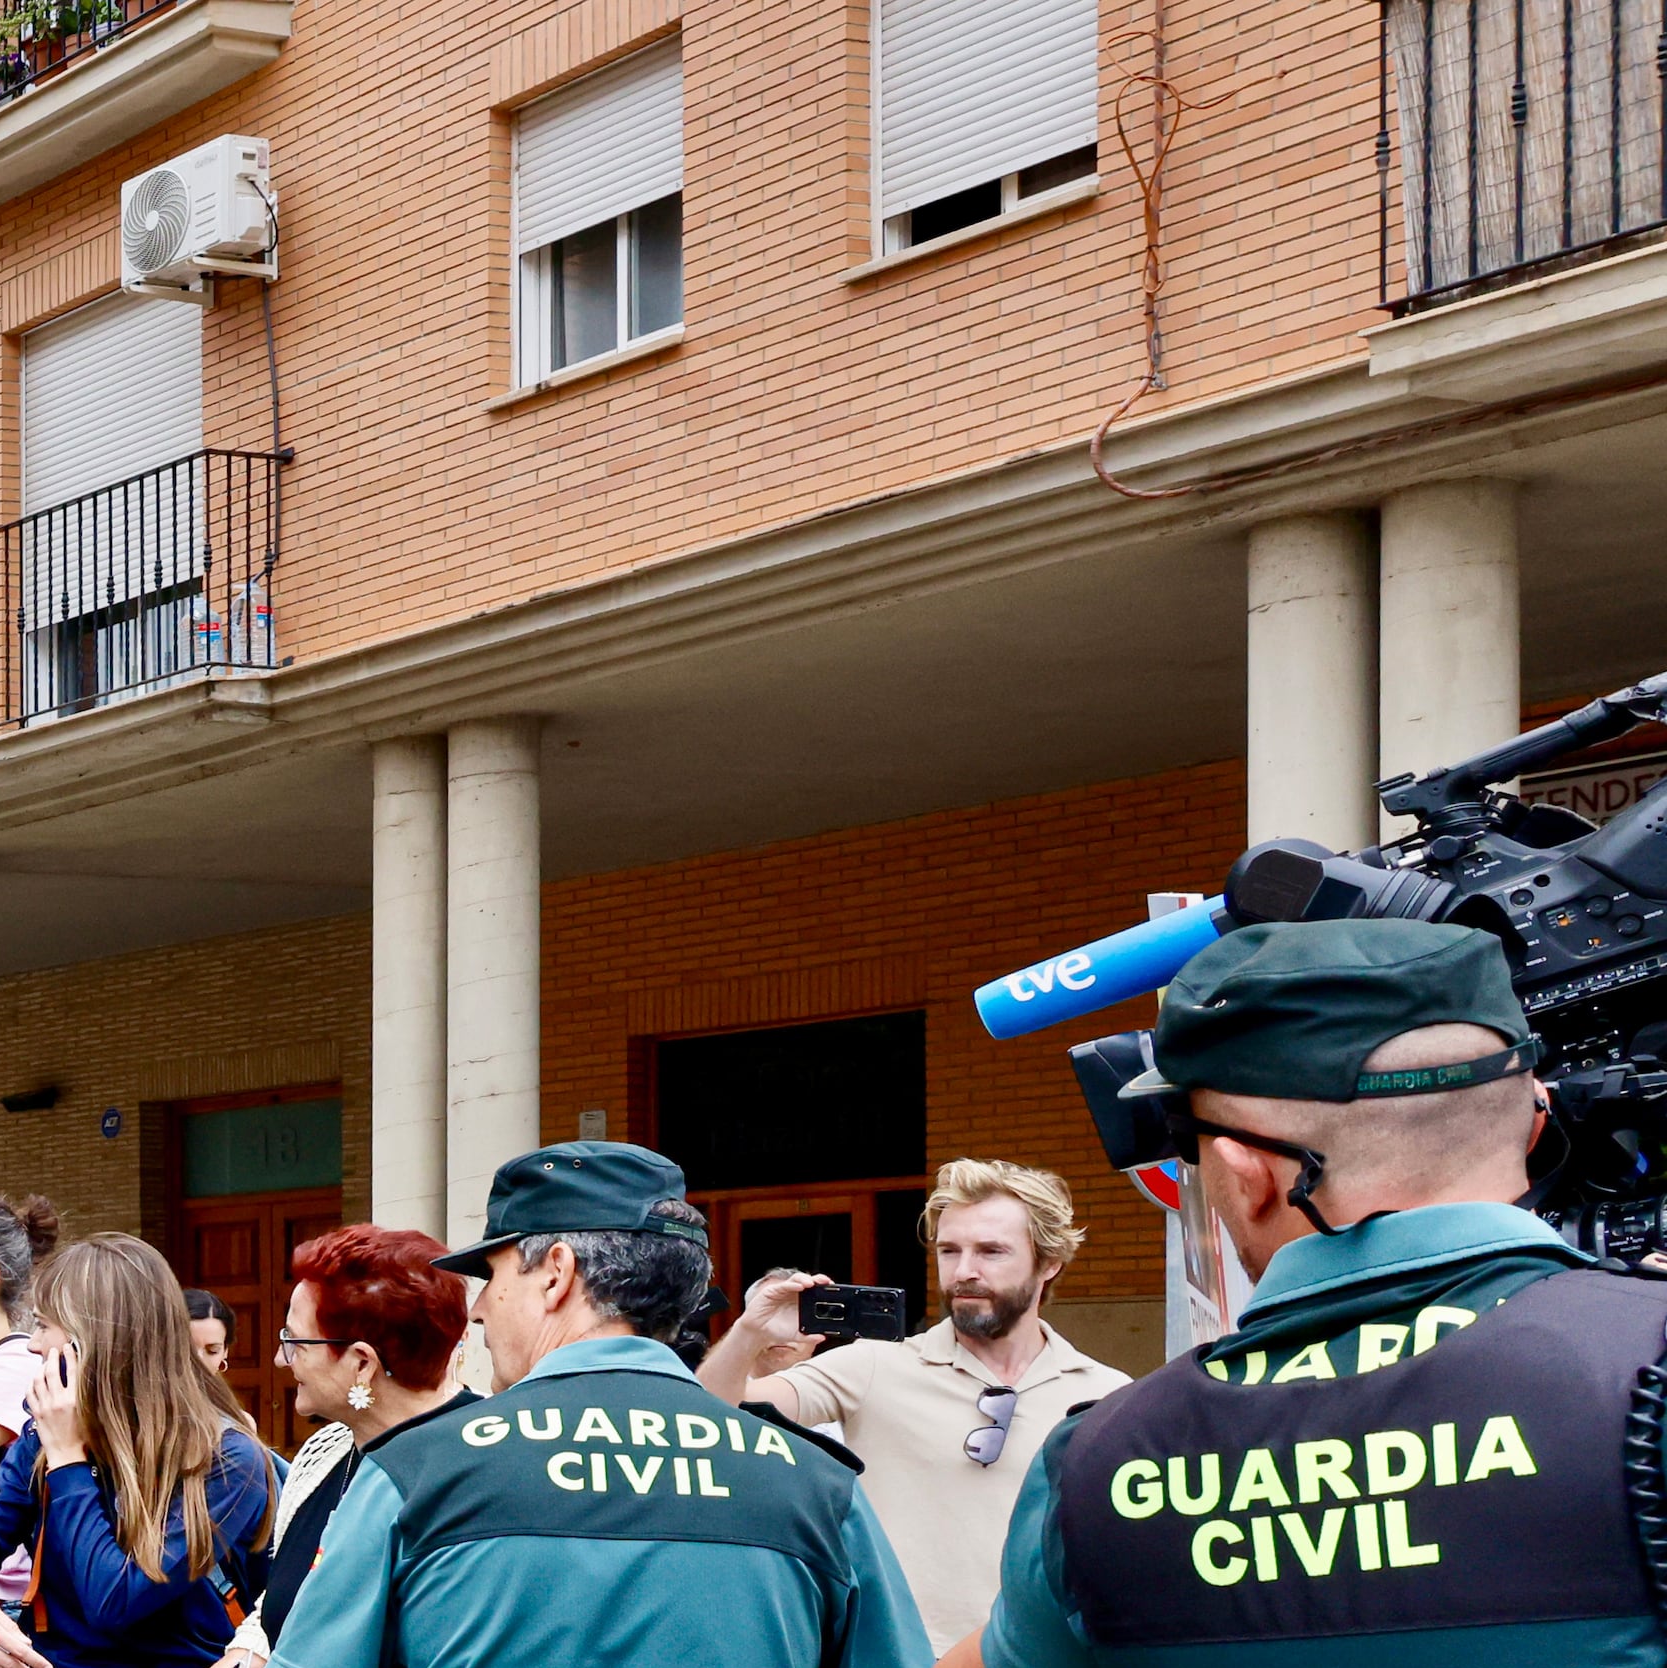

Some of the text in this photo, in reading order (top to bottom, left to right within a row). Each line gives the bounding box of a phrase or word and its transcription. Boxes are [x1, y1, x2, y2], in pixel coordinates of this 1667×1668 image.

[1003, 953, 1096, 1002] tve
[1357, 1071, 1432, 1092] GUARDIA
[461, 1408, 797, 1466] GUARDIA
[546, 1452, 730, 1497] CIVIL
[1110, 1415, 1537, 1520] GUARDIA
[1191, 1500, 1440, 1586] CIVIL
